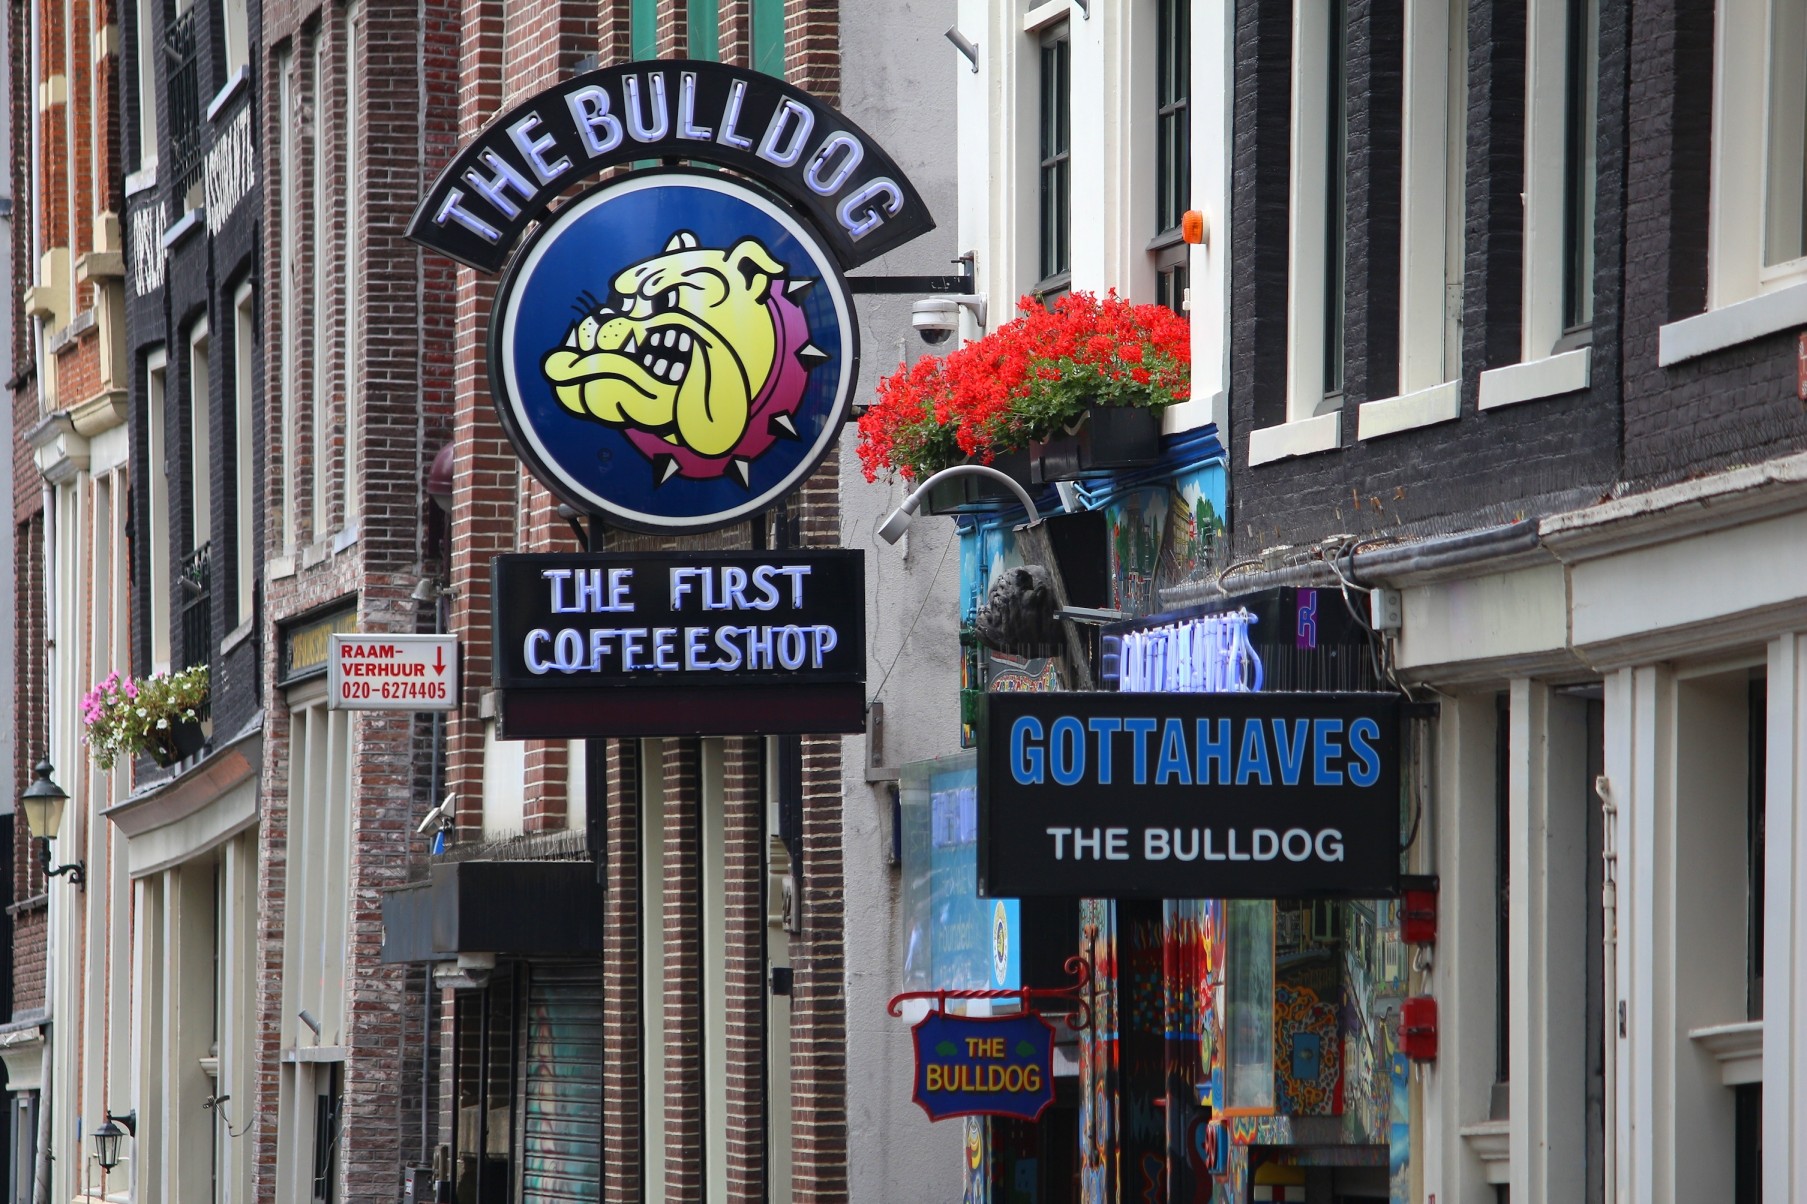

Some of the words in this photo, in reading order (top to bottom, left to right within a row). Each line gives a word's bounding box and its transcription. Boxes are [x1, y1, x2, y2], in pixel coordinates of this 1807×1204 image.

[433, 110, 574, 245] THE
[564, 71, 904, 243] BULLDOG
[541, 567, 635, 614] THE
[669, 565, 812, 612] FIRST
[341, 644, 404, 659] RAAM-
[523, 624, 838, 675] COFFEESHOP
[341, 663, 426, 677] VERHUUR
[342, 681, 446, 699] 020-6274405
[1009, 715, 1381, 788] GOTTAHAVES
[1046, 828, 1130, 861] THE
[1144, 828, 1345, 862] BULLDOG
[965, 1037, 1006, 1058] THE
[926, 1064, 1042, 1092] BULLDOG
